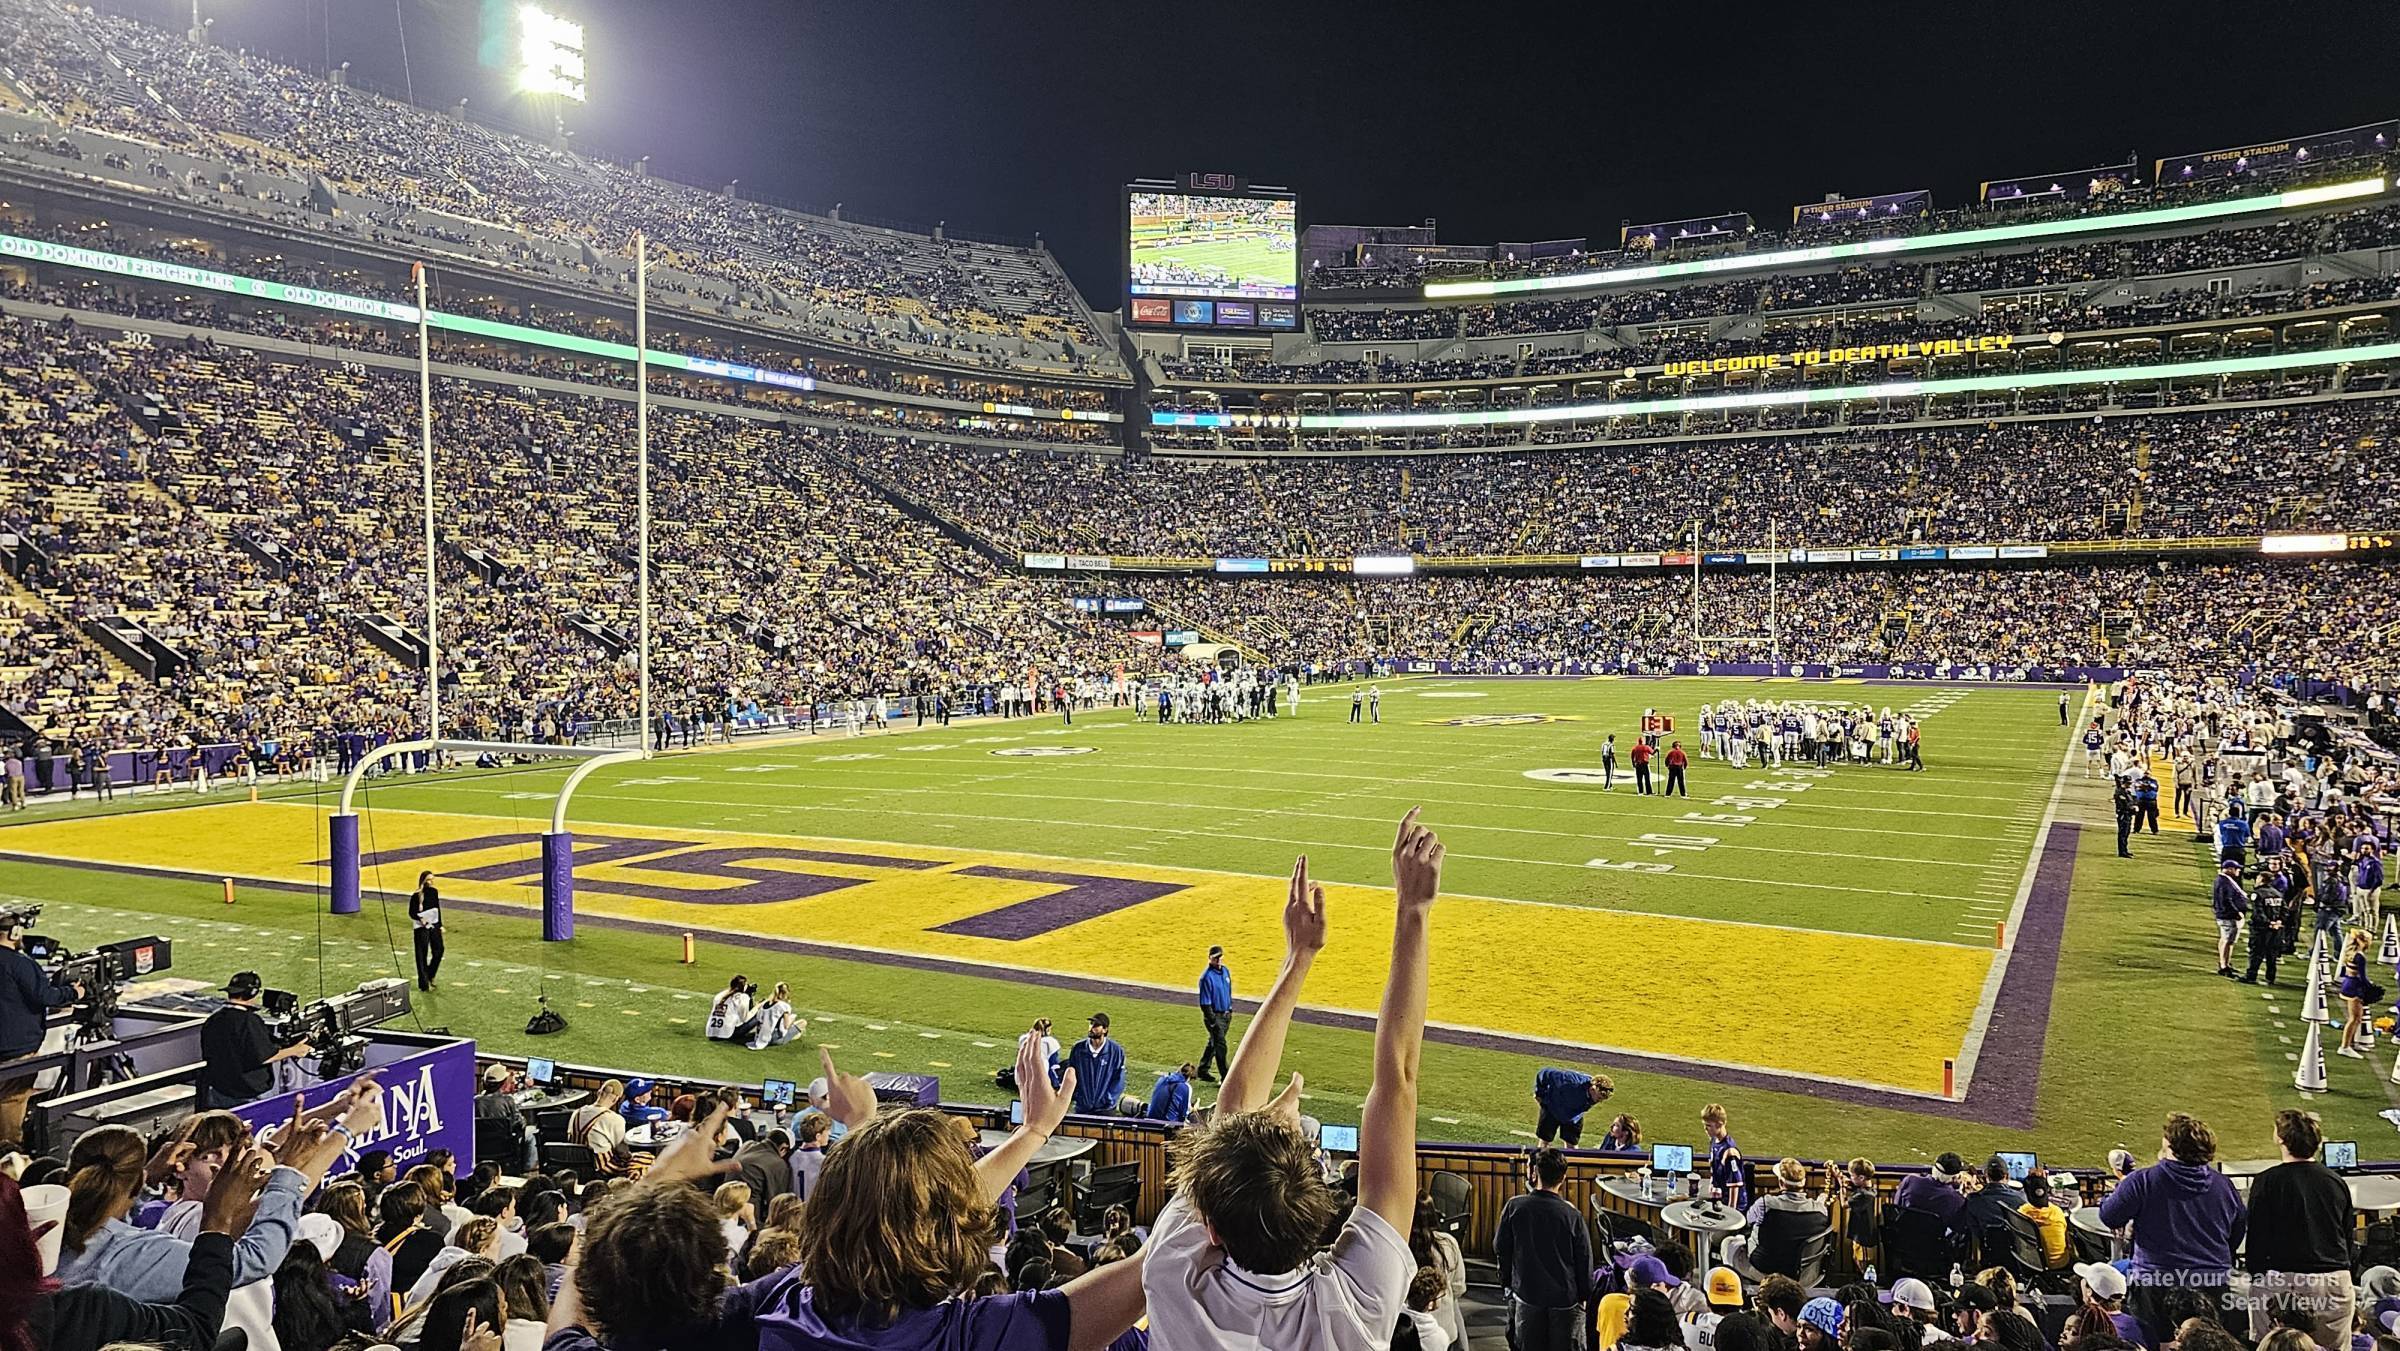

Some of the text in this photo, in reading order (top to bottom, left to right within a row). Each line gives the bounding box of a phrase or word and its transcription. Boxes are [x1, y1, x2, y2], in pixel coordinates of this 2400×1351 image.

[2212, 143, 2290, 162] TIGER STADIUM
[1191, 172, 1235, 190] LSU
[1810, 200, 1873, 214] TIGER STADIUM
[1, 238, 38, 256] OLD
[41, 246, 126, 272] DOMINION
[135, 262, 197, 284] FREIGHT
[283, 286, 314, 301] OLD
[315, 291, 381, 314] DOMINION
[122, 330, 151, 346] 302
[1664, 335, 2013, 376] WELCOME TO DEATH VALLEY
[341, 360, 366, 376] 303
[1408, 663, 1436, 673] LSU
[1733, 725, 1739, 735] 5
[1785, 719, 1797, 727] 55
[1584, 858, 1676, 873] 5
[2264, 897, 2283, 906] POLICE
[2383, 923, 2398, 957] LSU
[711, 1018, 724, 1028] 29
[393, 1140, 428, 1164] Soul.
